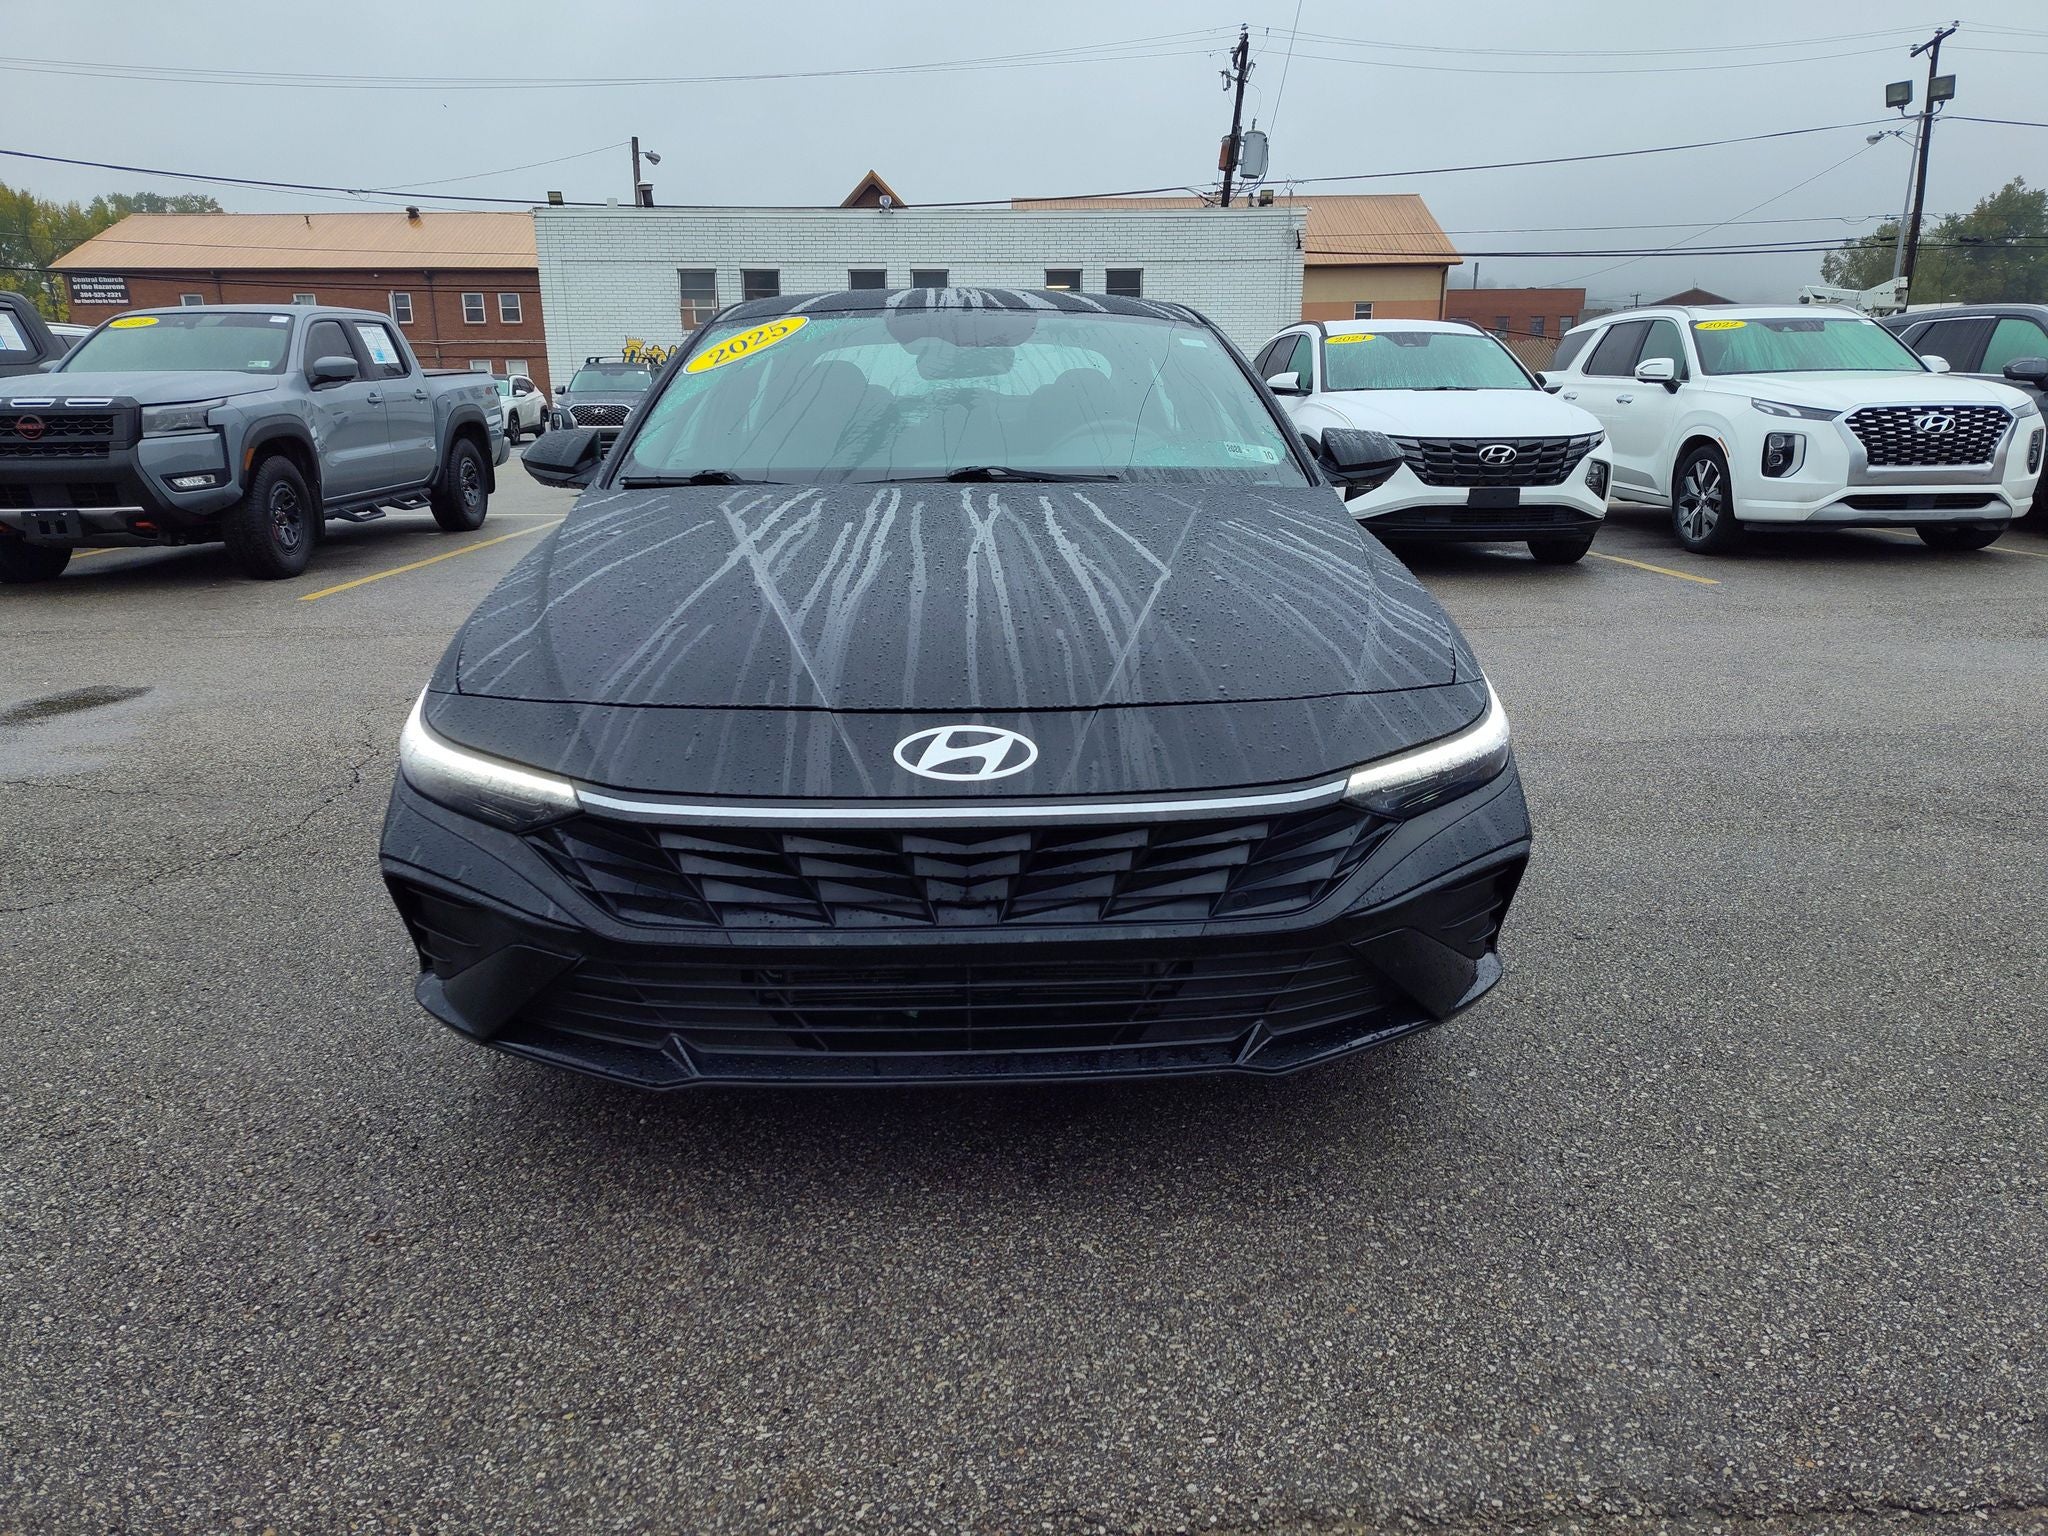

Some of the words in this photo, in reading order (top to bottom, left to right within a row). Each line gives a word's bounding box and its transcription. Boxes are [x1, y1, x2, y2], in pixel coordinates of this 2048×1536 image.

[1704, 321, 1738, 329] 2022
[708, 322, 788, 365] 2025
[1263, 450, 1274, 460] 10
